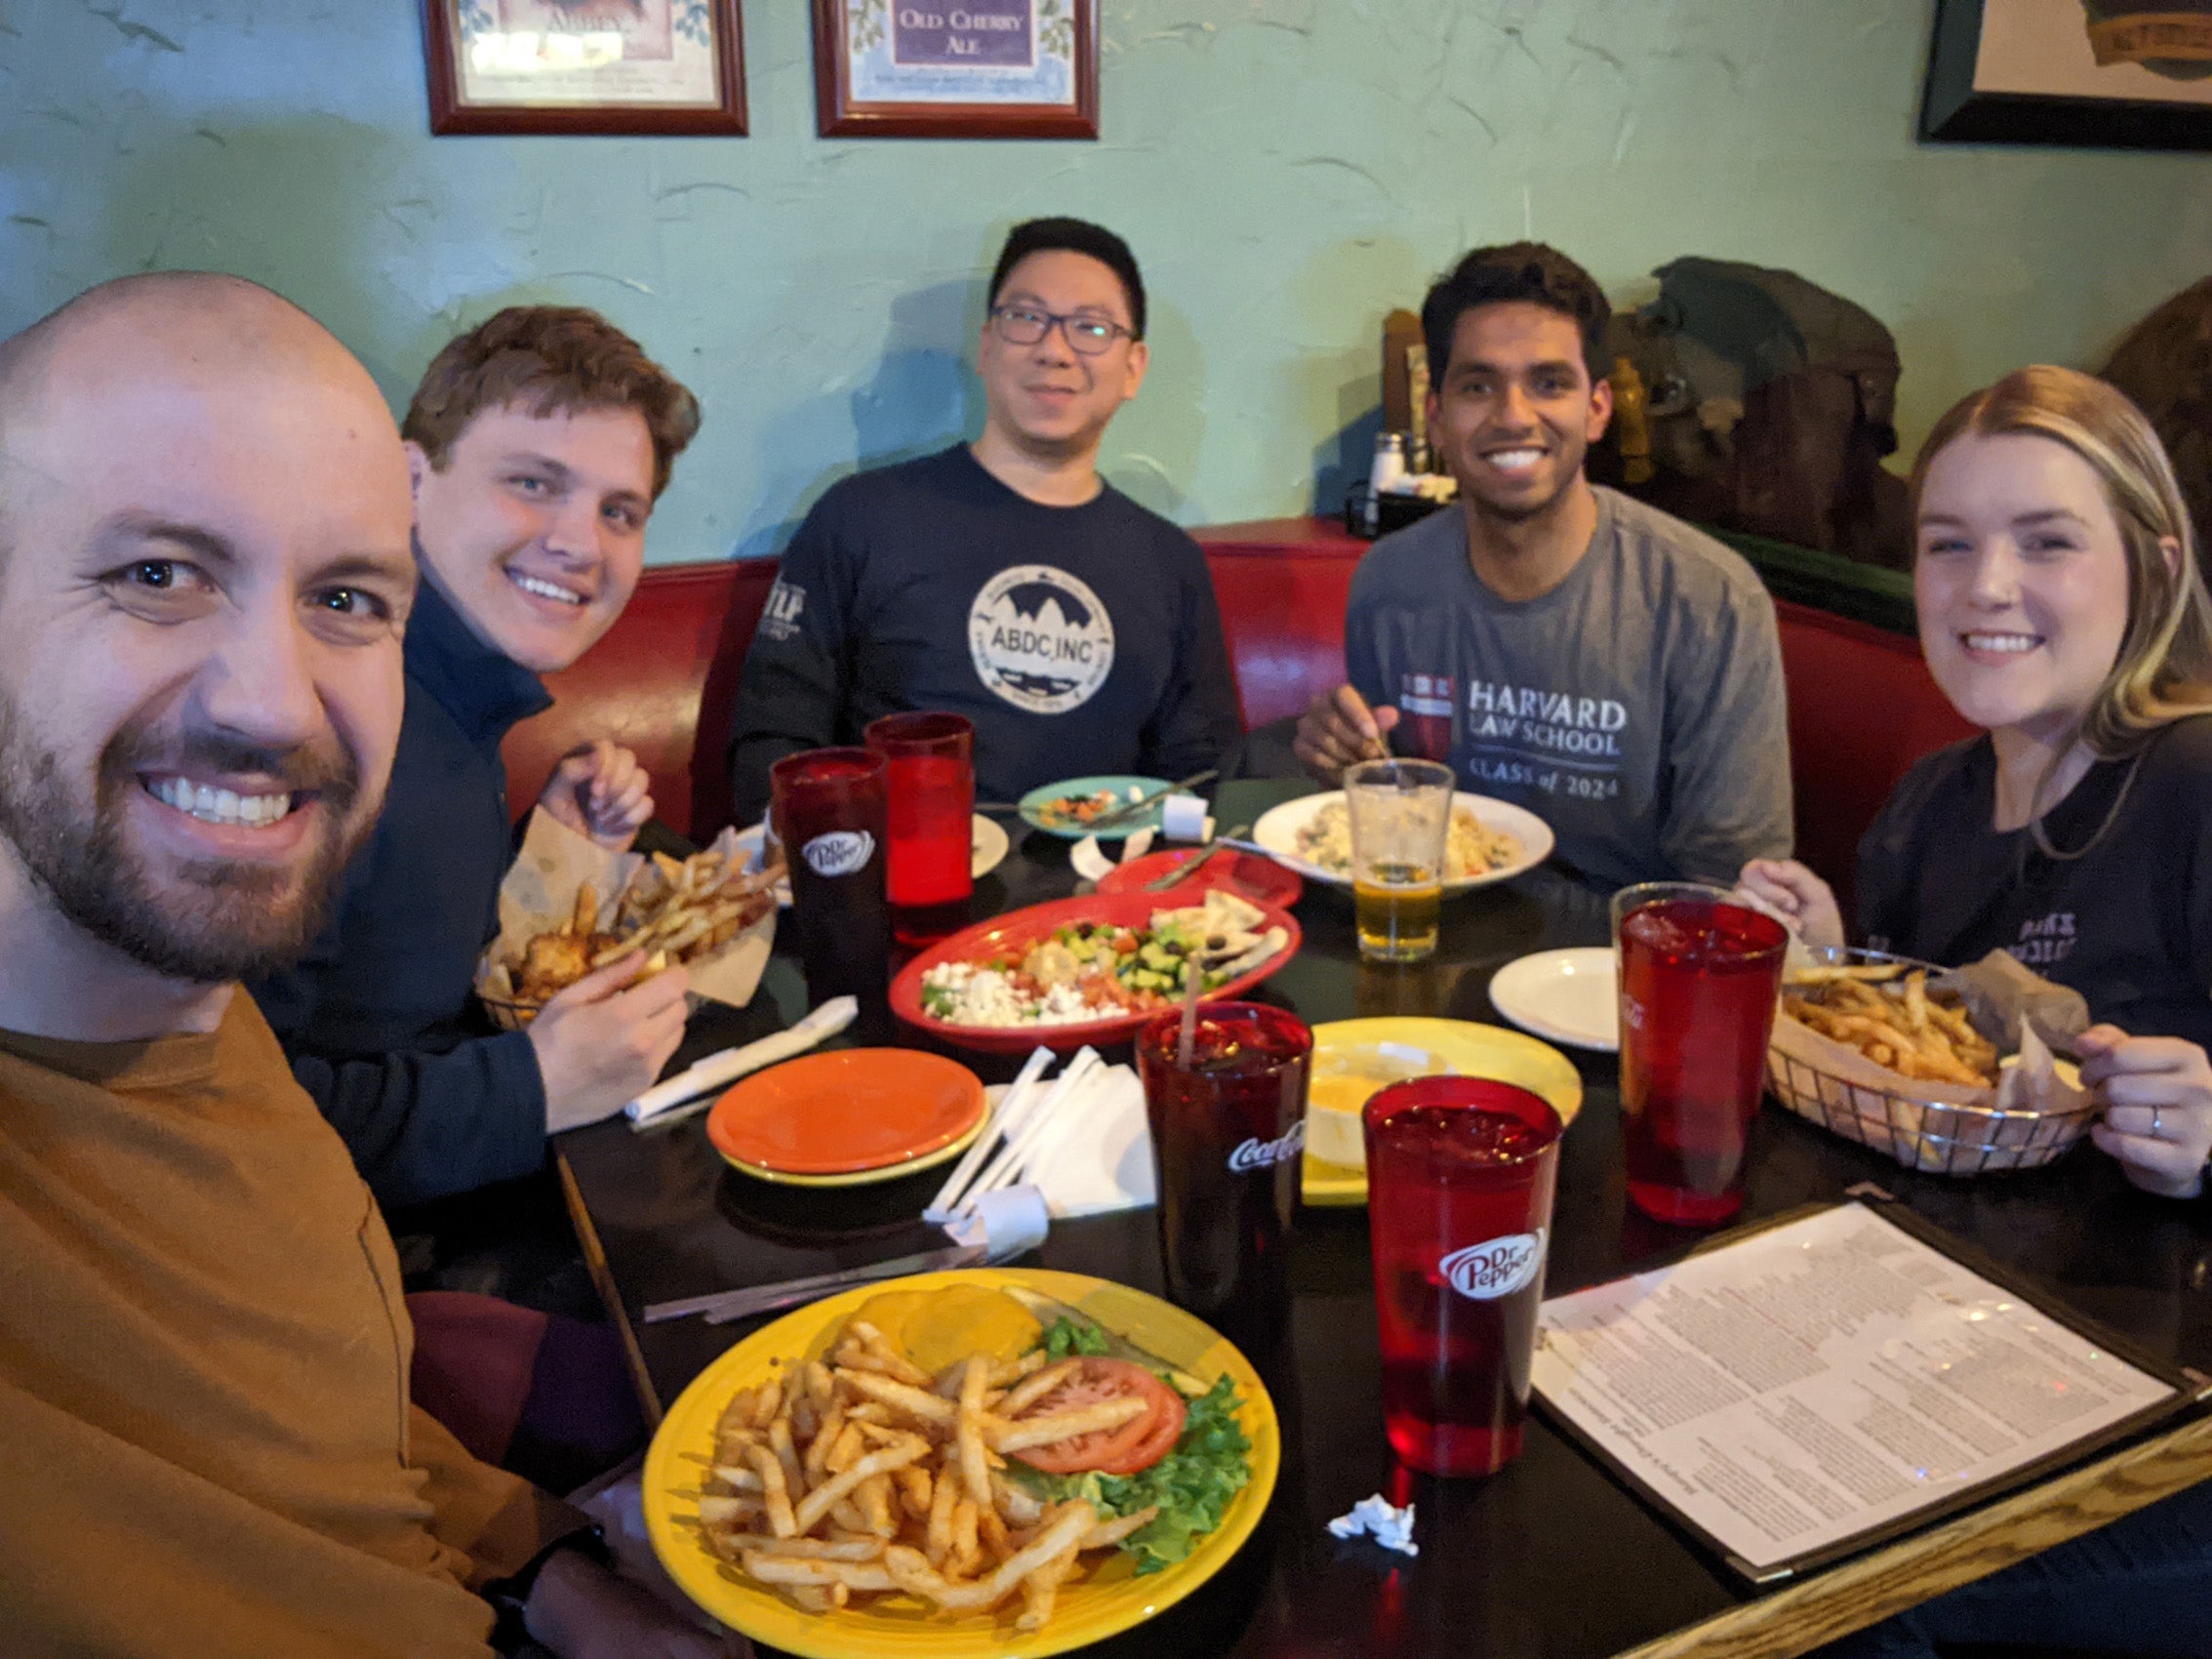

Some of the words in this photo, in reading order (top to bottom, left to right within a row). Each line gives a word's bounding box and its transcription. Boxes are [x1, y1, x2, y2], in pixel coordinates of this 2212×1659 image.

[900, 8, 944, 30] OLD
[949, 10, 1022, 31] CHERRY
[945, 35, 981, 56] ALE
[1468, 679, 1628, 731] HARVARD
[1468, 712, 1517, 739] LAW
[1521, 720, 1621, 756] SCHOOL
[1469, 757, 1534, 785] CLASS
[1567, 775, 1618, 800] 2024
[1456, 1246, 1533, 1291] Pepper
[1491, 1245, 1519, 1270] Dr
